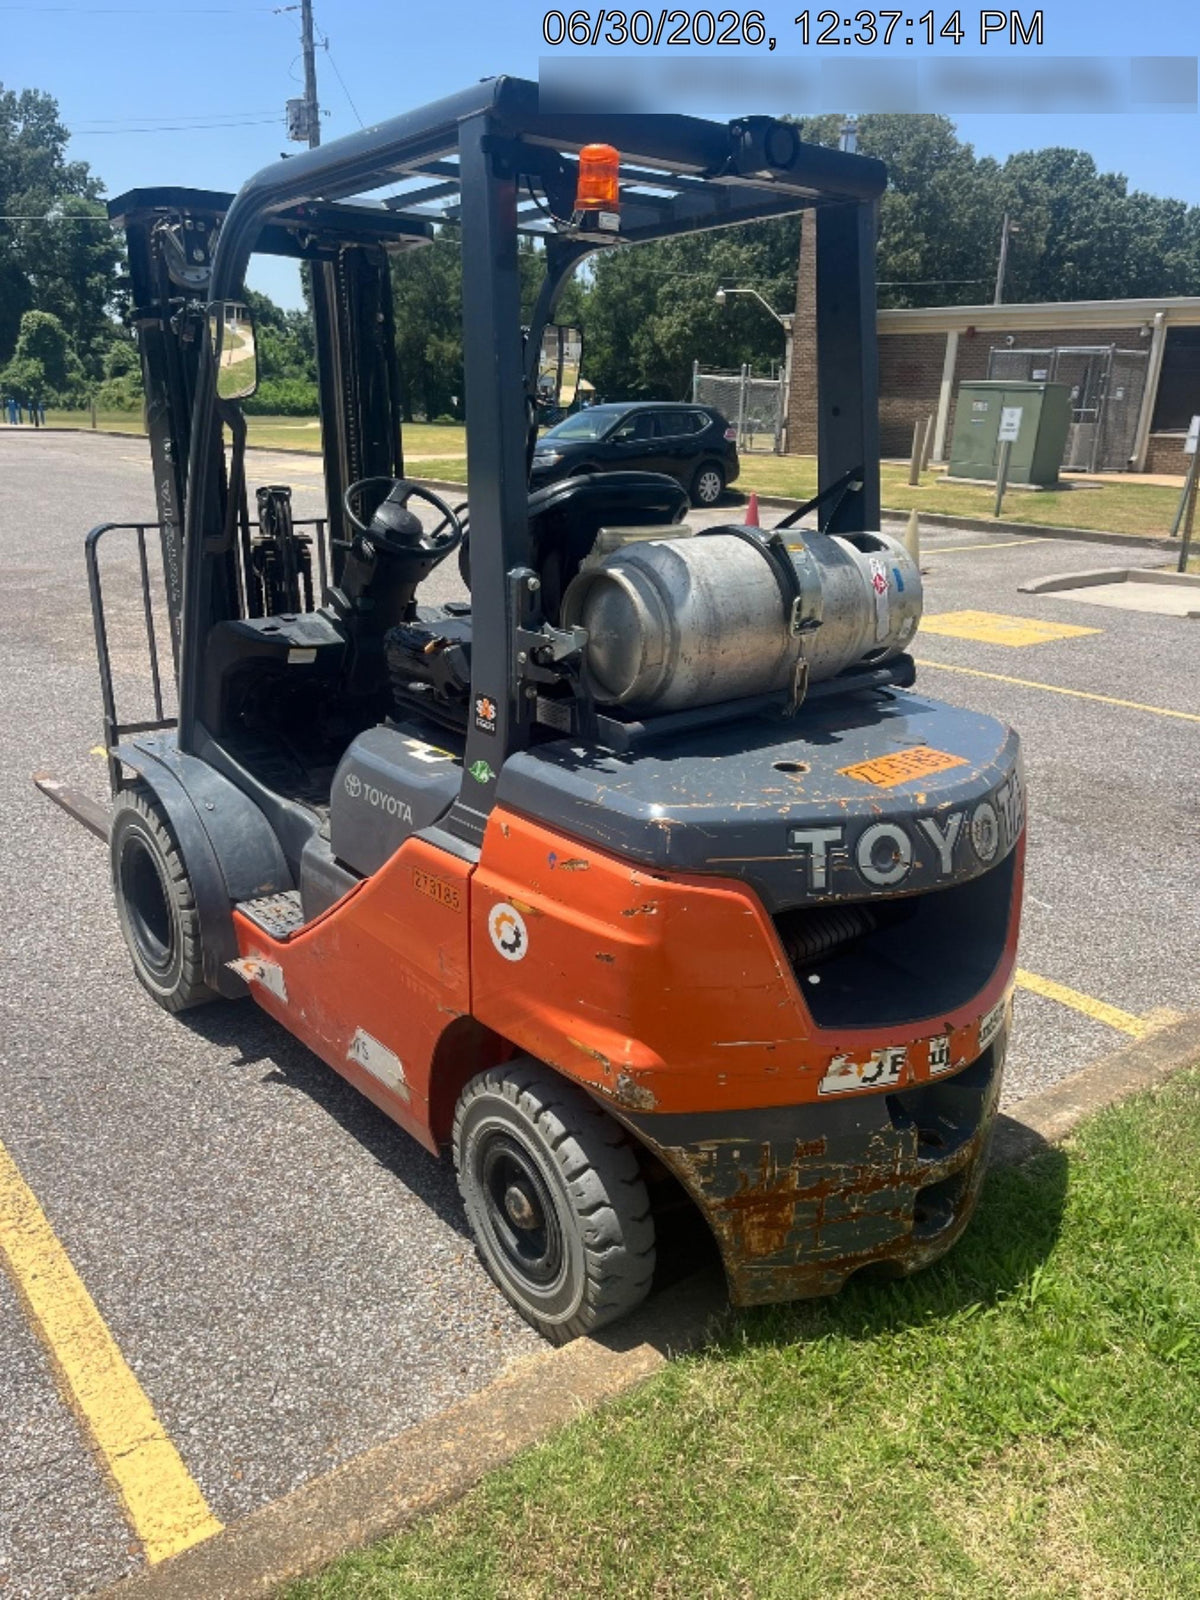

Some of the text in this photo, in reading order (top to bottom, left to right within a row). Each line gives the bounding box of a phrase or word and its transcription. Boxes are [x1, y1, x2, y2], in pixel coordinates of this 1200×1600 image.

[363, 784, 414, 825] TOYOTA
[793, 772, 1025, 889] TOYOTA
[415, 870, 460, 909] 273185
